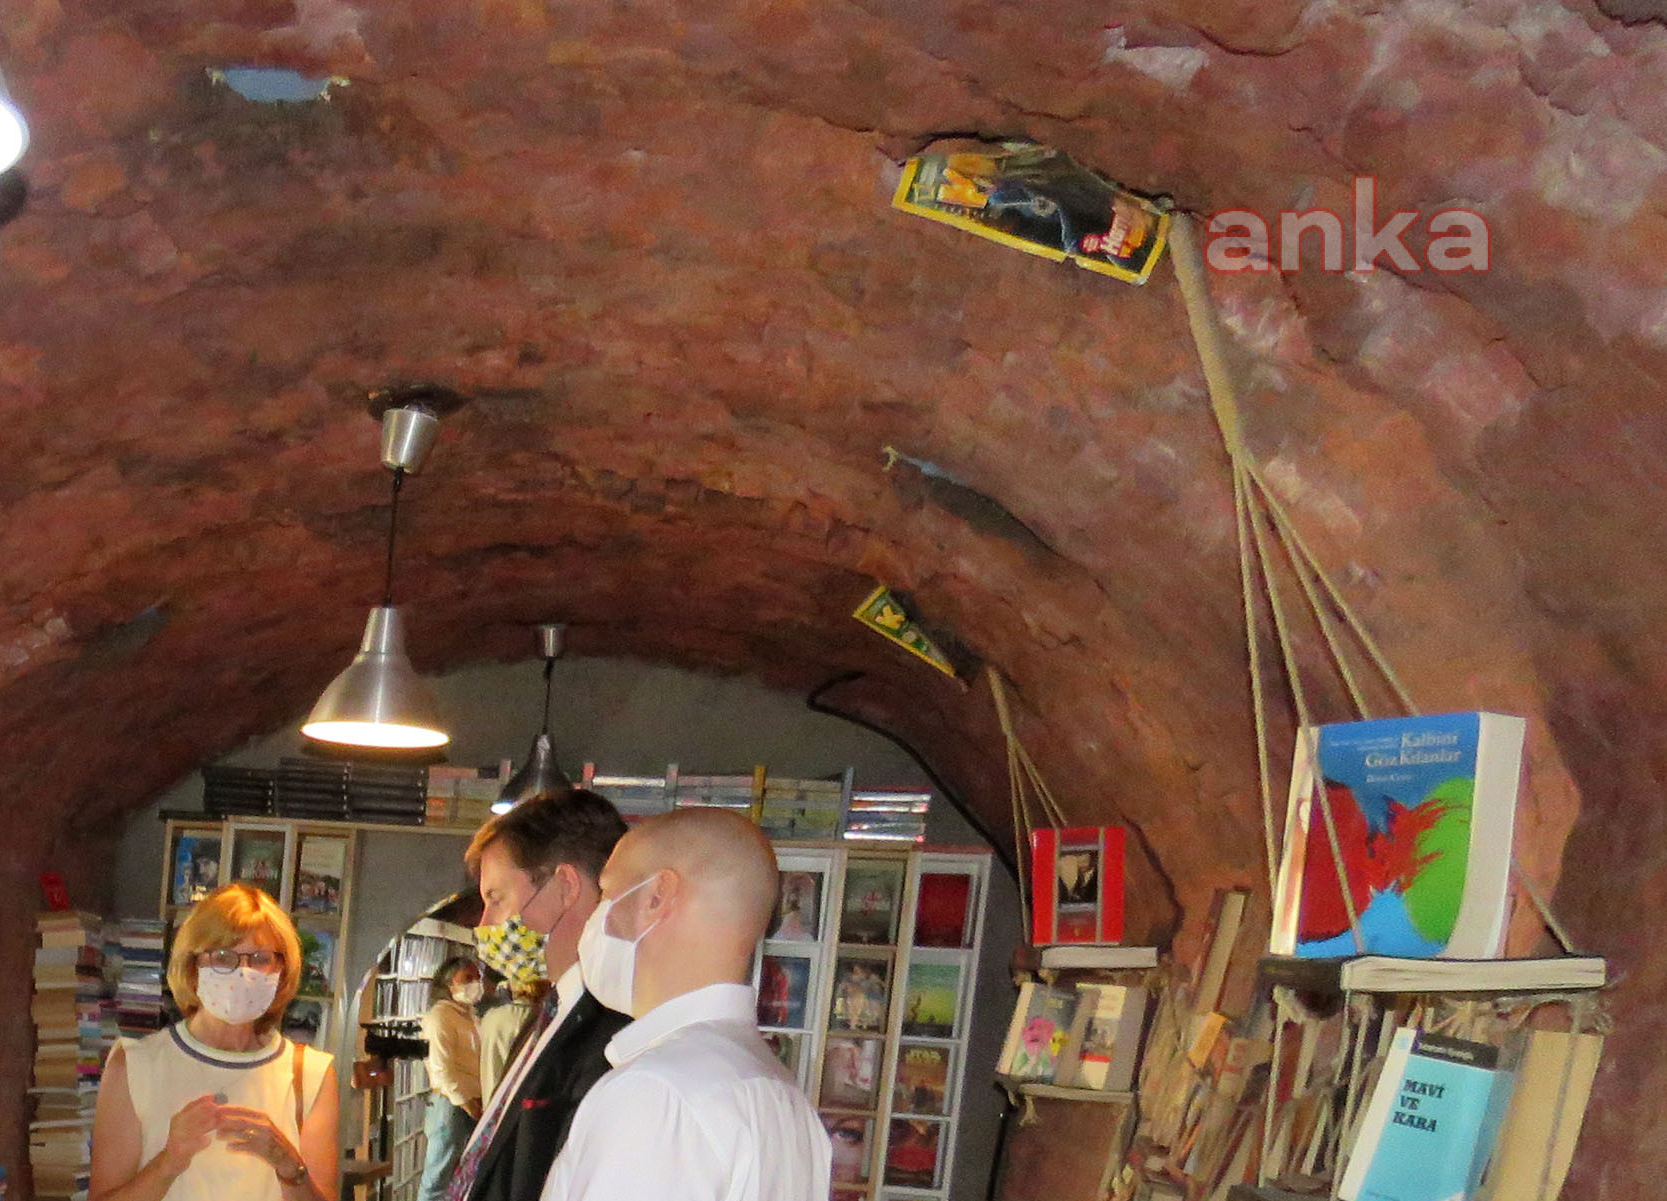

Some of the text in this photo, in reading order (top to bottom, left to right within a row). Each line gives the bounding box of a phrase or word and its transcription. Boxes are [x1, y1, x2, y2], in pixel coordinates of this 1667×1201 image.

[1404, 1079, 1446, 1098] MAVİ
[1400, 1095, 1420, 1110] VE
[1393, 1111, 1437, 1132] KARA
